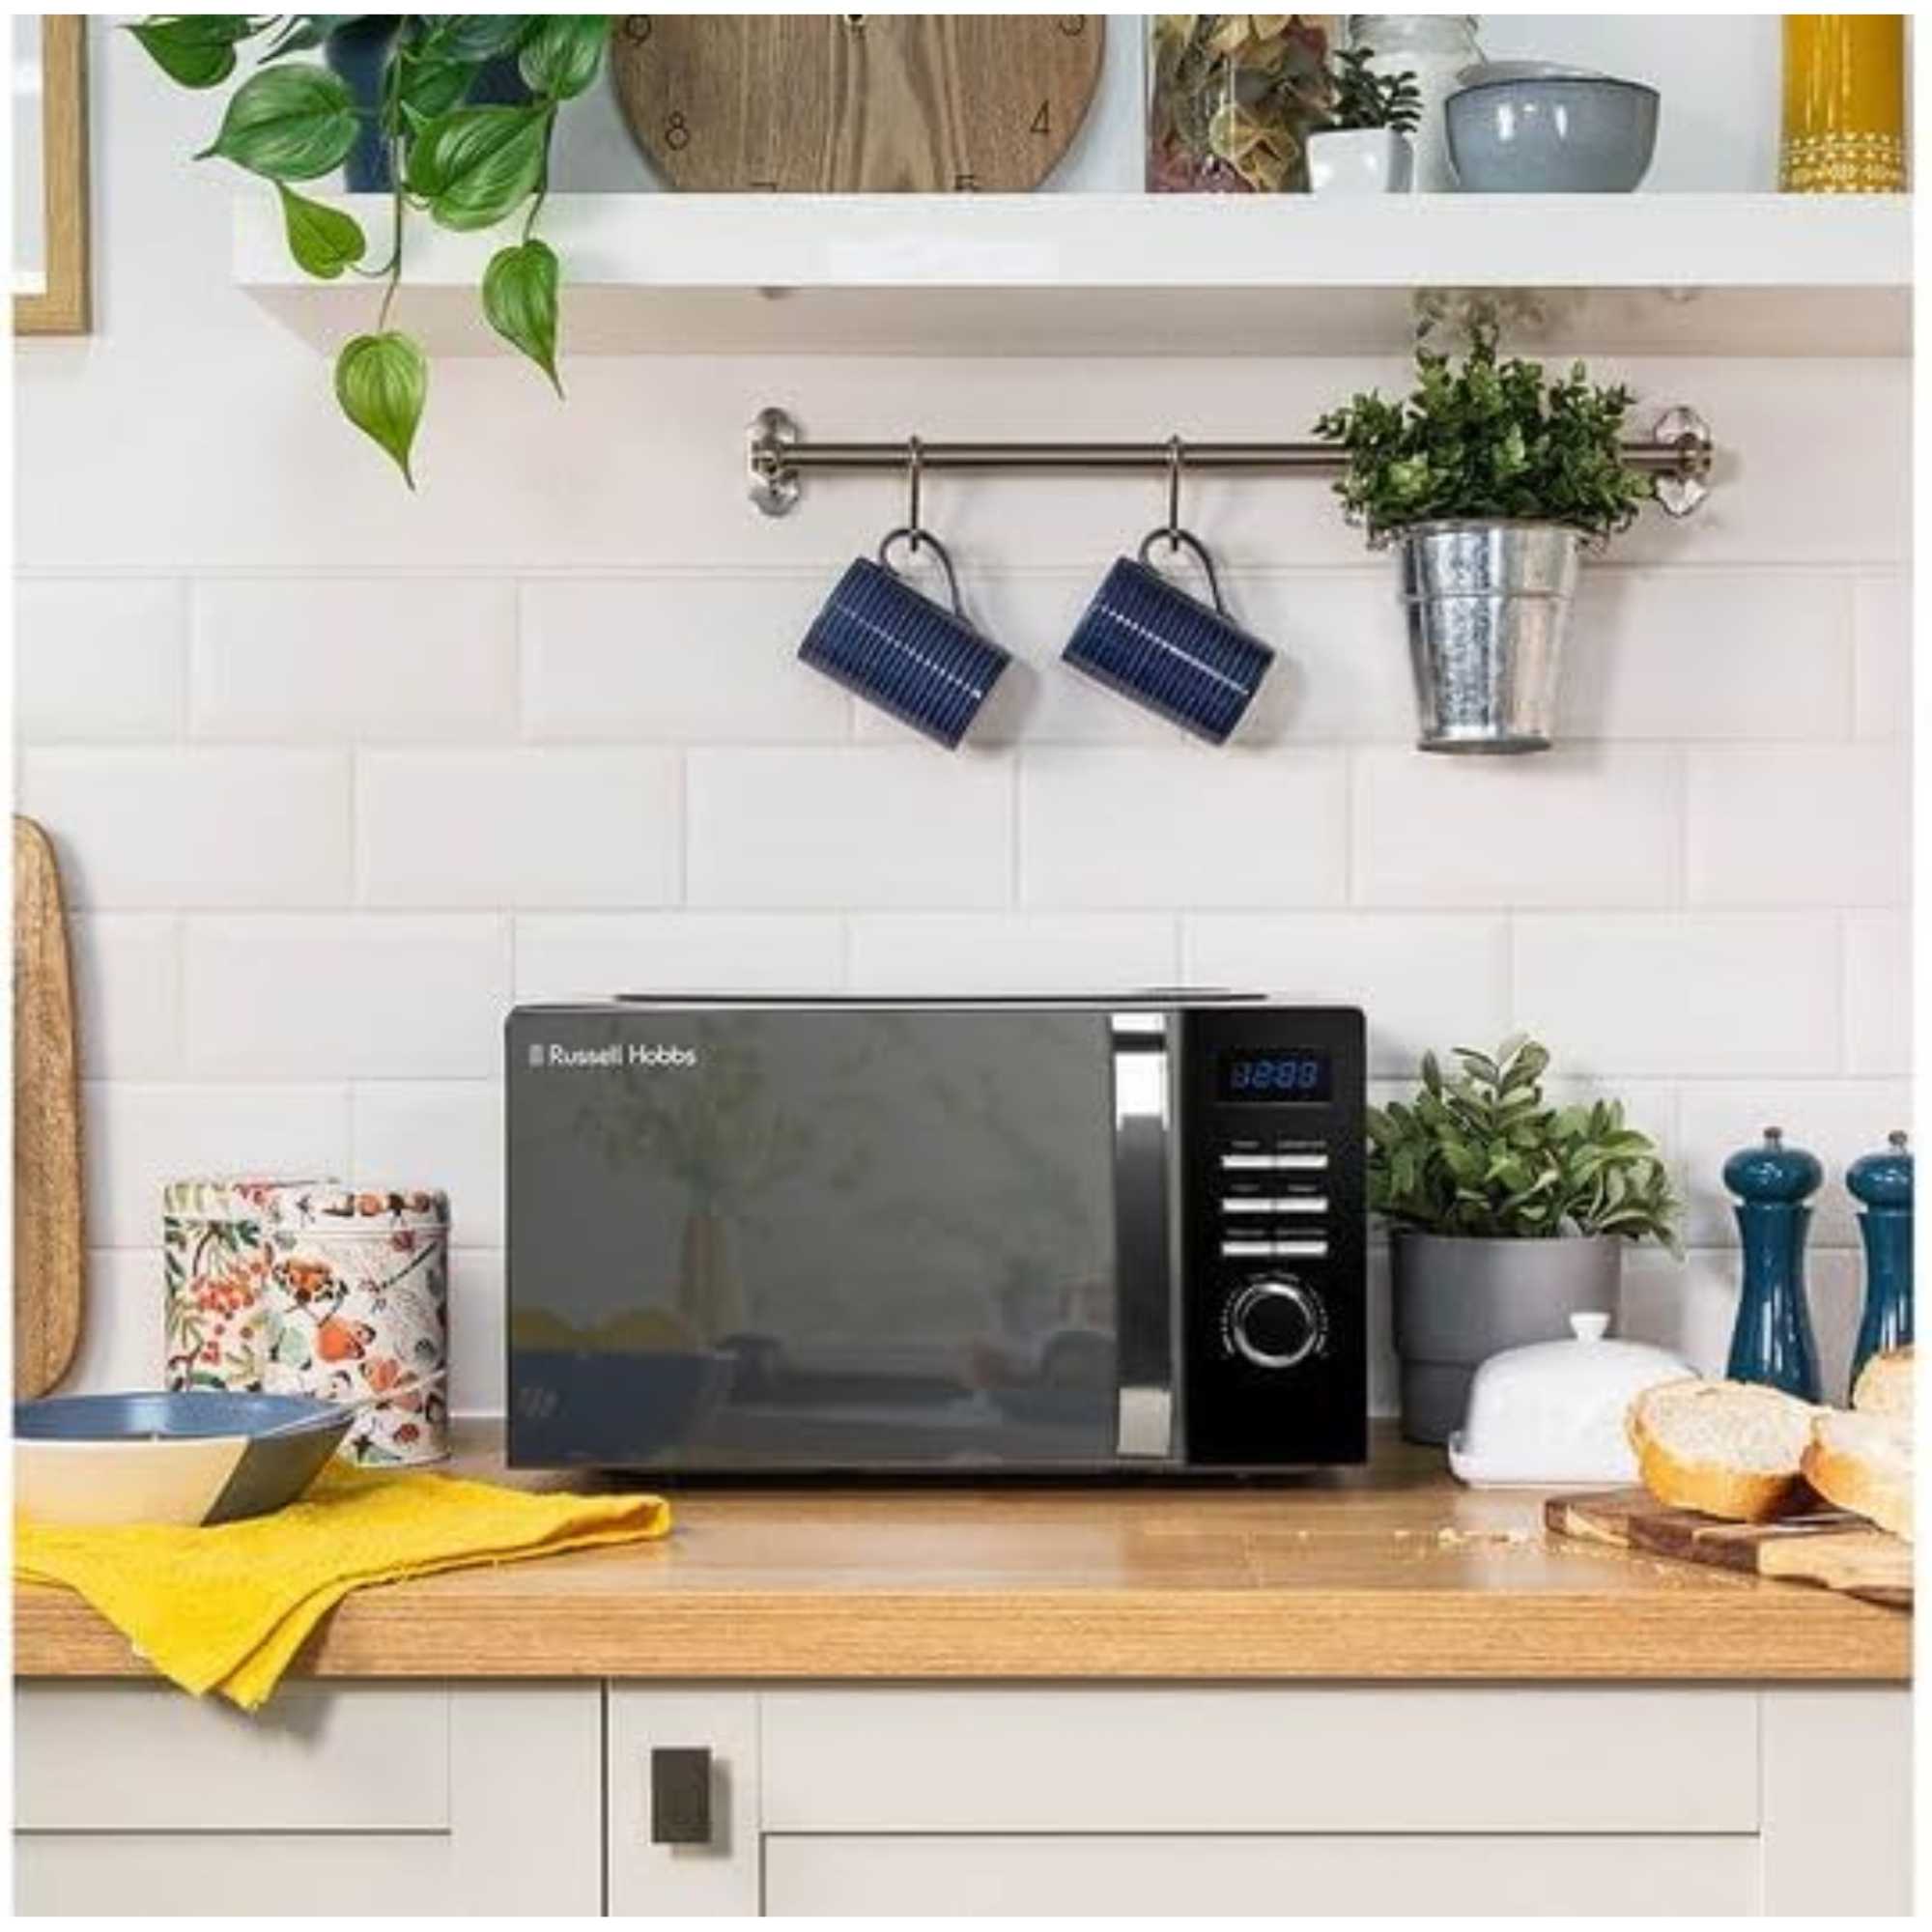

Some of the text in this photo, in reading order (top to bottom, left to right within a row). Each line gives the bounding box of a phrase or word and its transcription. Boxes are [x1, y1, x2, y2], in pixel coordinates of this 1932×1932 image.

[665, 110, 691, 152] 8
[1030, 99, 1050, 137] 4
[549, 1043, 696, 1066] Russell Hobbs
